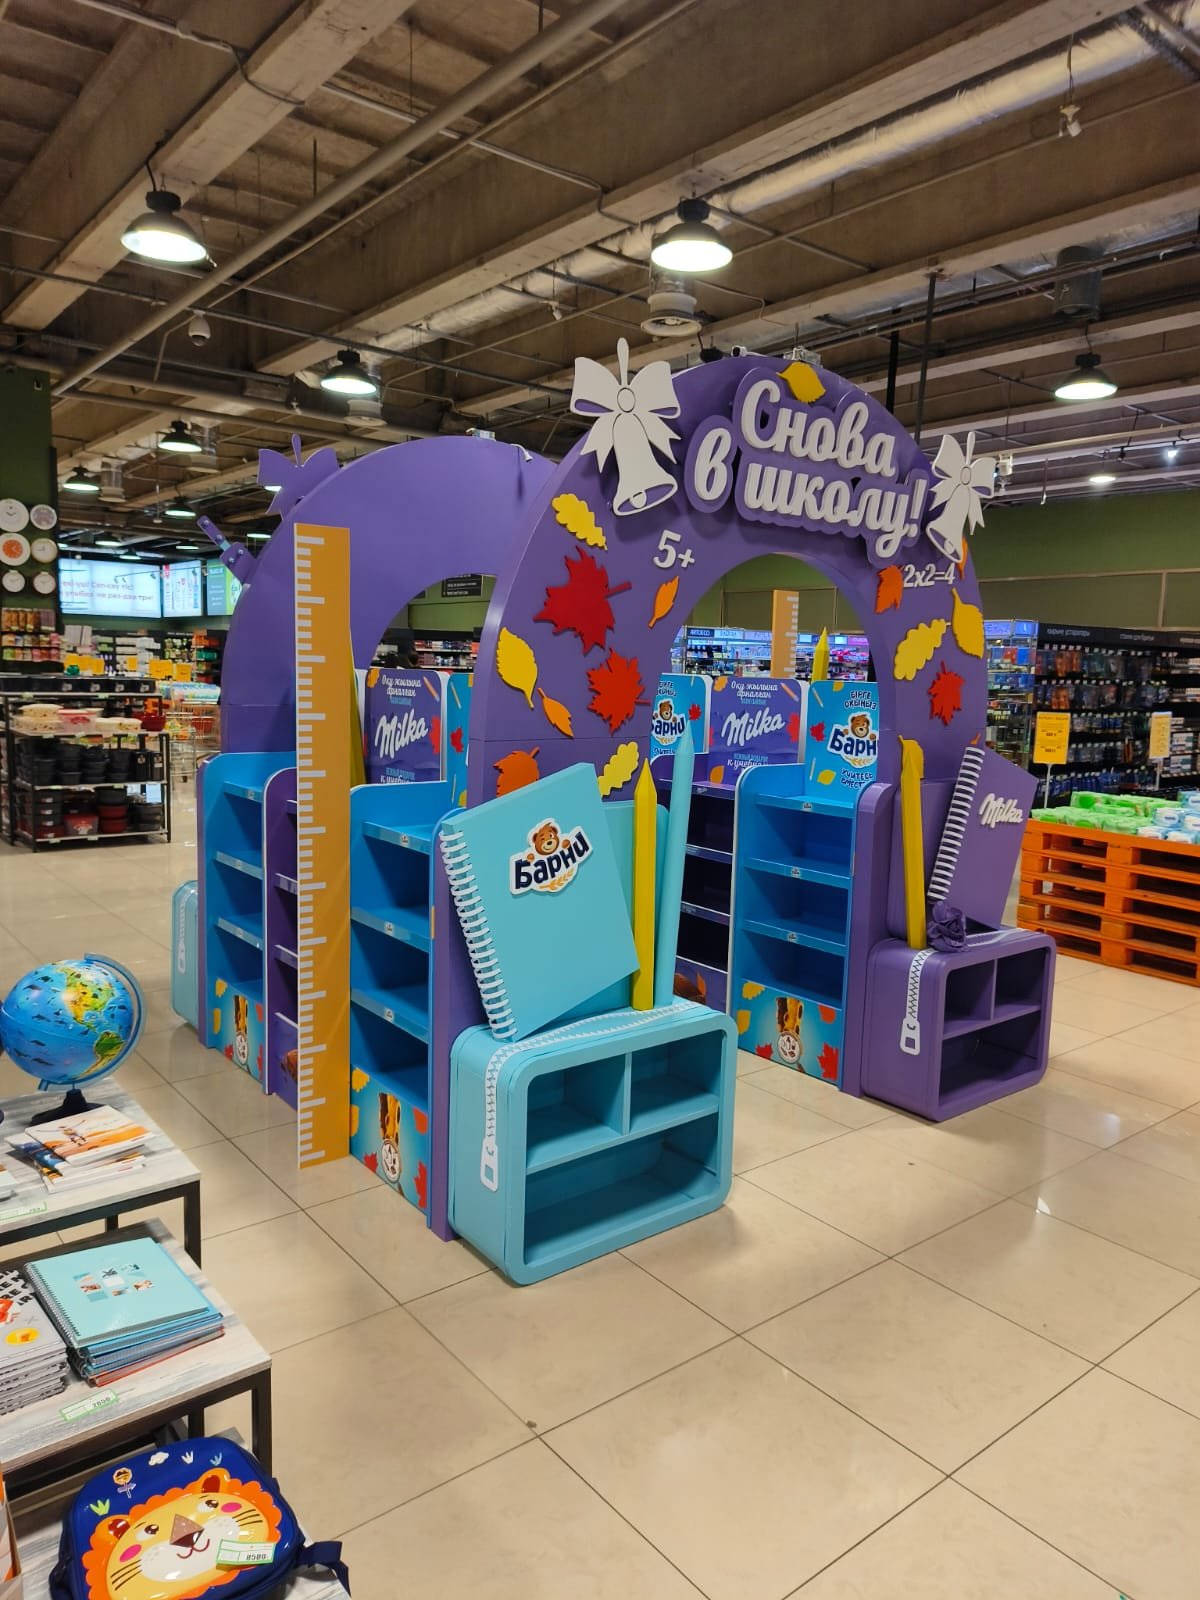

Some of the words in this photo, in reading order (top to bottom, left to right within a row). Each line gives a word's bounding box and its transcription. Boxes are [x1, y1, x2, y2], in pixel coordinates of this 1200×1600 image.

[741, 379, 896, 477] Снова
[694, 427, 732, 500] в
[744, 463, 928, 558] школу!
[653, 529, 695, 568] 5+
[375, 708, 428, 759] Milka
[721, 706, 786, 747] Milka
[830, 728, 877, 756] Барн
[979, 793, 1023, 828] Milka
[515, 831, 590, 889] Барни
